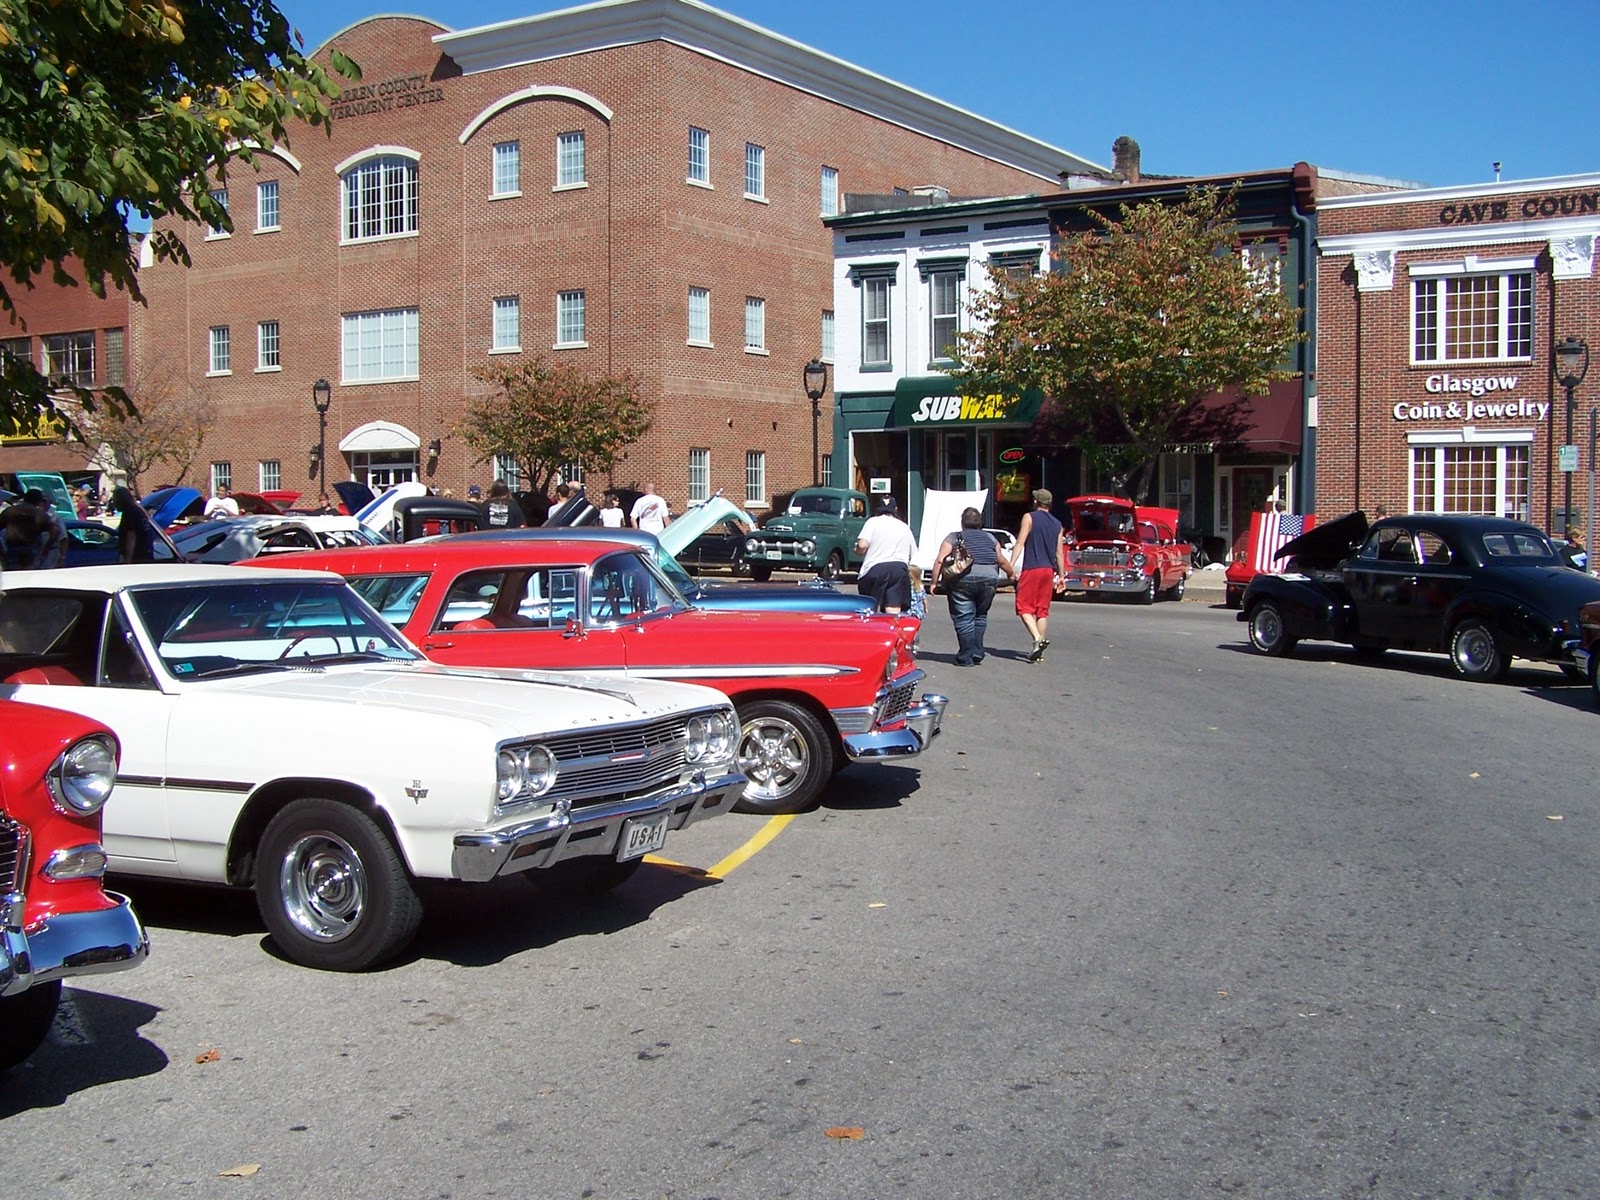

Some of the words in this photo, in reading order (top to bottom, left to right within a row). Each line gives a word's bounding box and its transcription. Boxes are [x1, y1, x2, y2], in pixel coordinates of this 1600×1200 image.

[379, 75, 427, 96] COUNTY
[397, 88, 445, 108] CENTER
[1439, 201, 1508, 225] CAVE
[1521, 192, 1598, 217] COUN
[1425, 374, 1517, 396] Glasgow
[1393, 401, 1442, 420] Coin
[1445, 401, 1462, 418] &
[1465, 398, 1550, 421] Jewelry
[1003, 450, 1024, 460] OPEN
